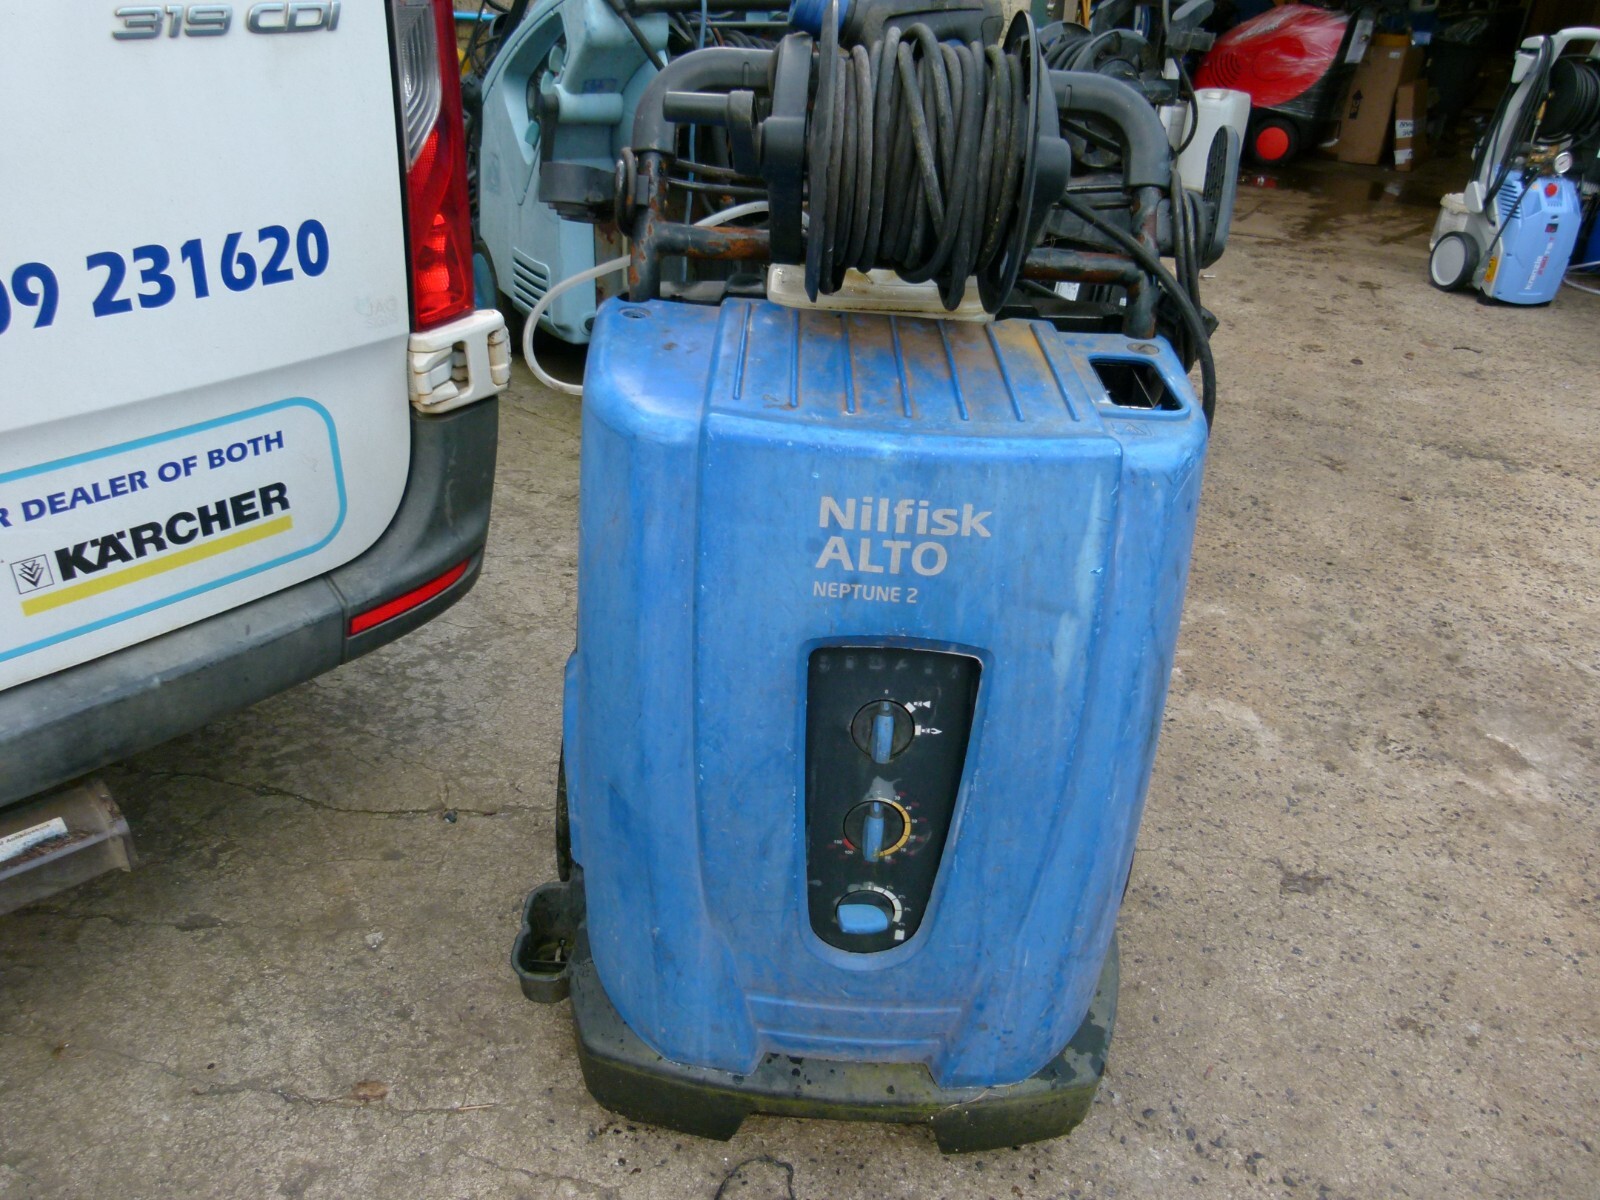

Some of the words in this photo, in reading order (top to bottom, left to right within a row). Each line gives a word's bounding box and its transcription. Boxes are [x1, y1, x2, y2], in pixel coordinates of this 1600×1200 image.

[112, 3, 234, 40] 319
[246, 1, 341, 34] CDI
[86, 219, 329, 318] 231620
[21, 470, 149, 523] DEALER
[157, 455, 198, 483] OF
[207, 430, 285, 470] BOTH
[54, 481, 291, 582] KÄRCHER
[818, 495, 993, 538] Nilfisk
[814, 535, 948, 577] ALTO
[812, 580, 902, 603] NEPTUNE
[905, 587, 919, 604] 2
